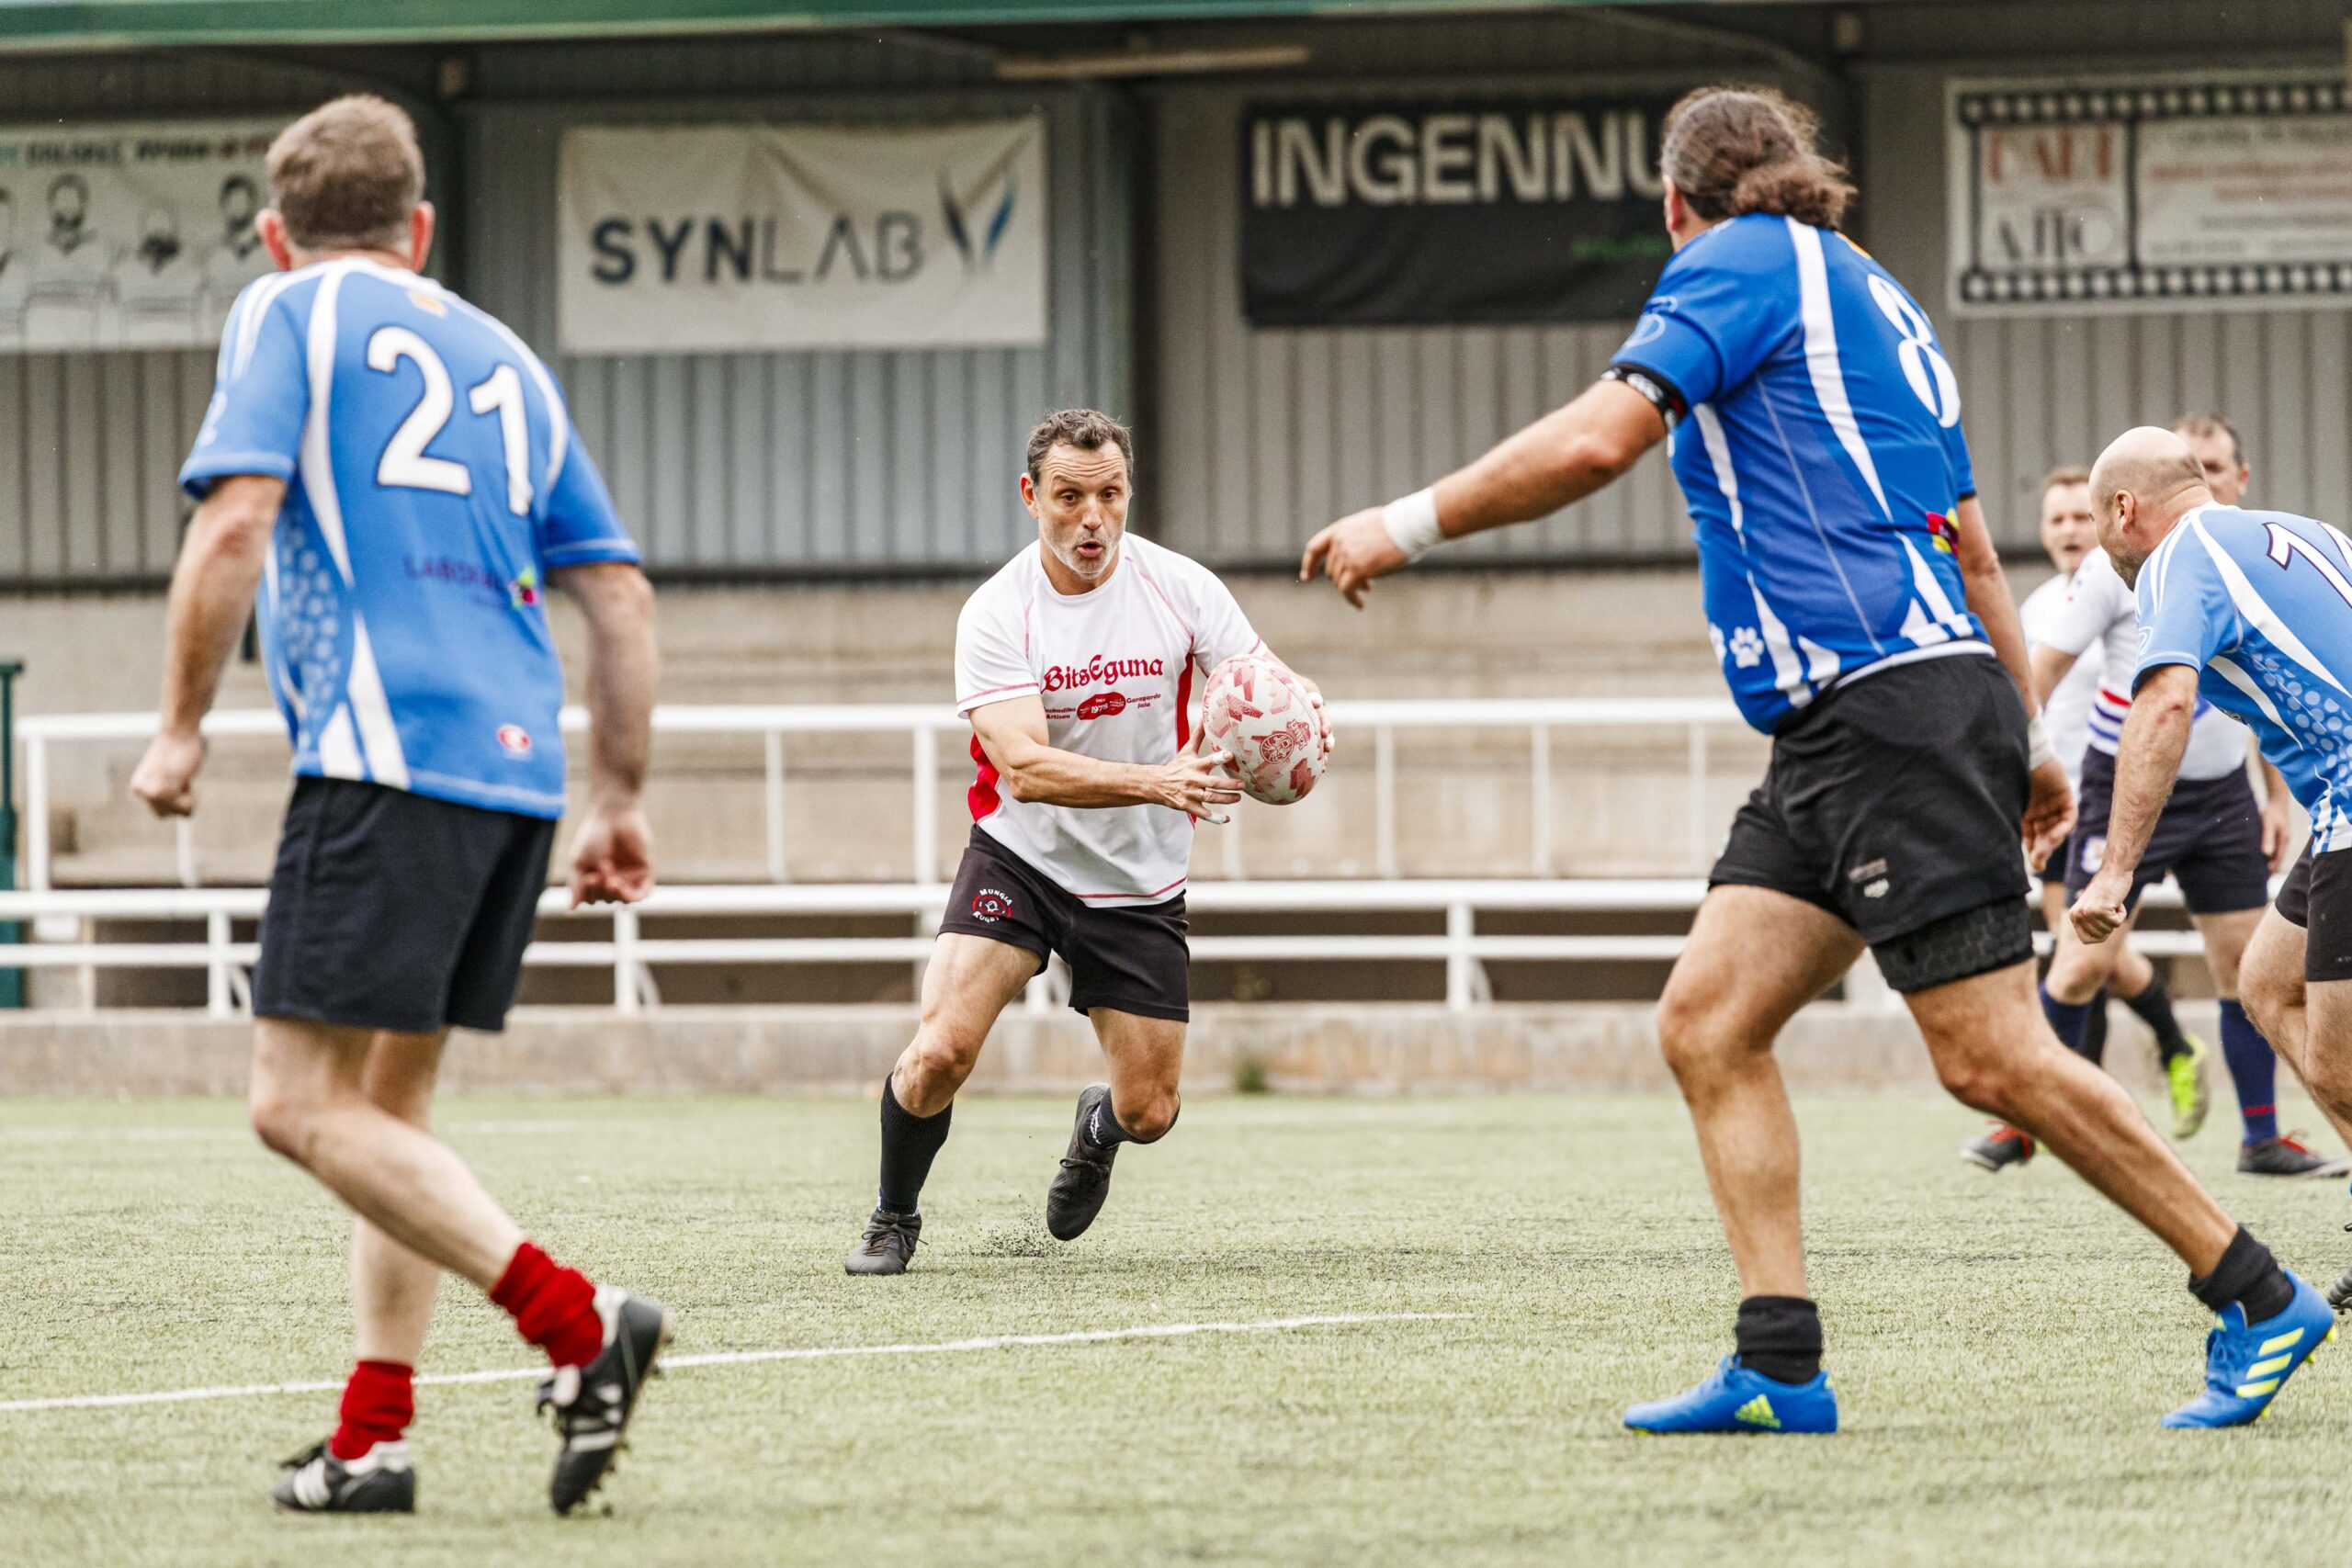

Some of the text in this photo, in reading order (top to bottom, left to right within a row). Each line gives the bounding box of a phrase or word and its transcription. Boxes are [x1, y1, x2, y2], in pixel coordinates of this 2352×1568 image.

[592, 212, 923, 285] SYNLAB
[1867, 273, 1962, 428] 8
[367, 325, 533, 517] 21
[2262, 521, 2352, 610] 1
[1040, 654, 1164, 694] BitsEguna
[979, 888, 1012, 906] MUNGIA
